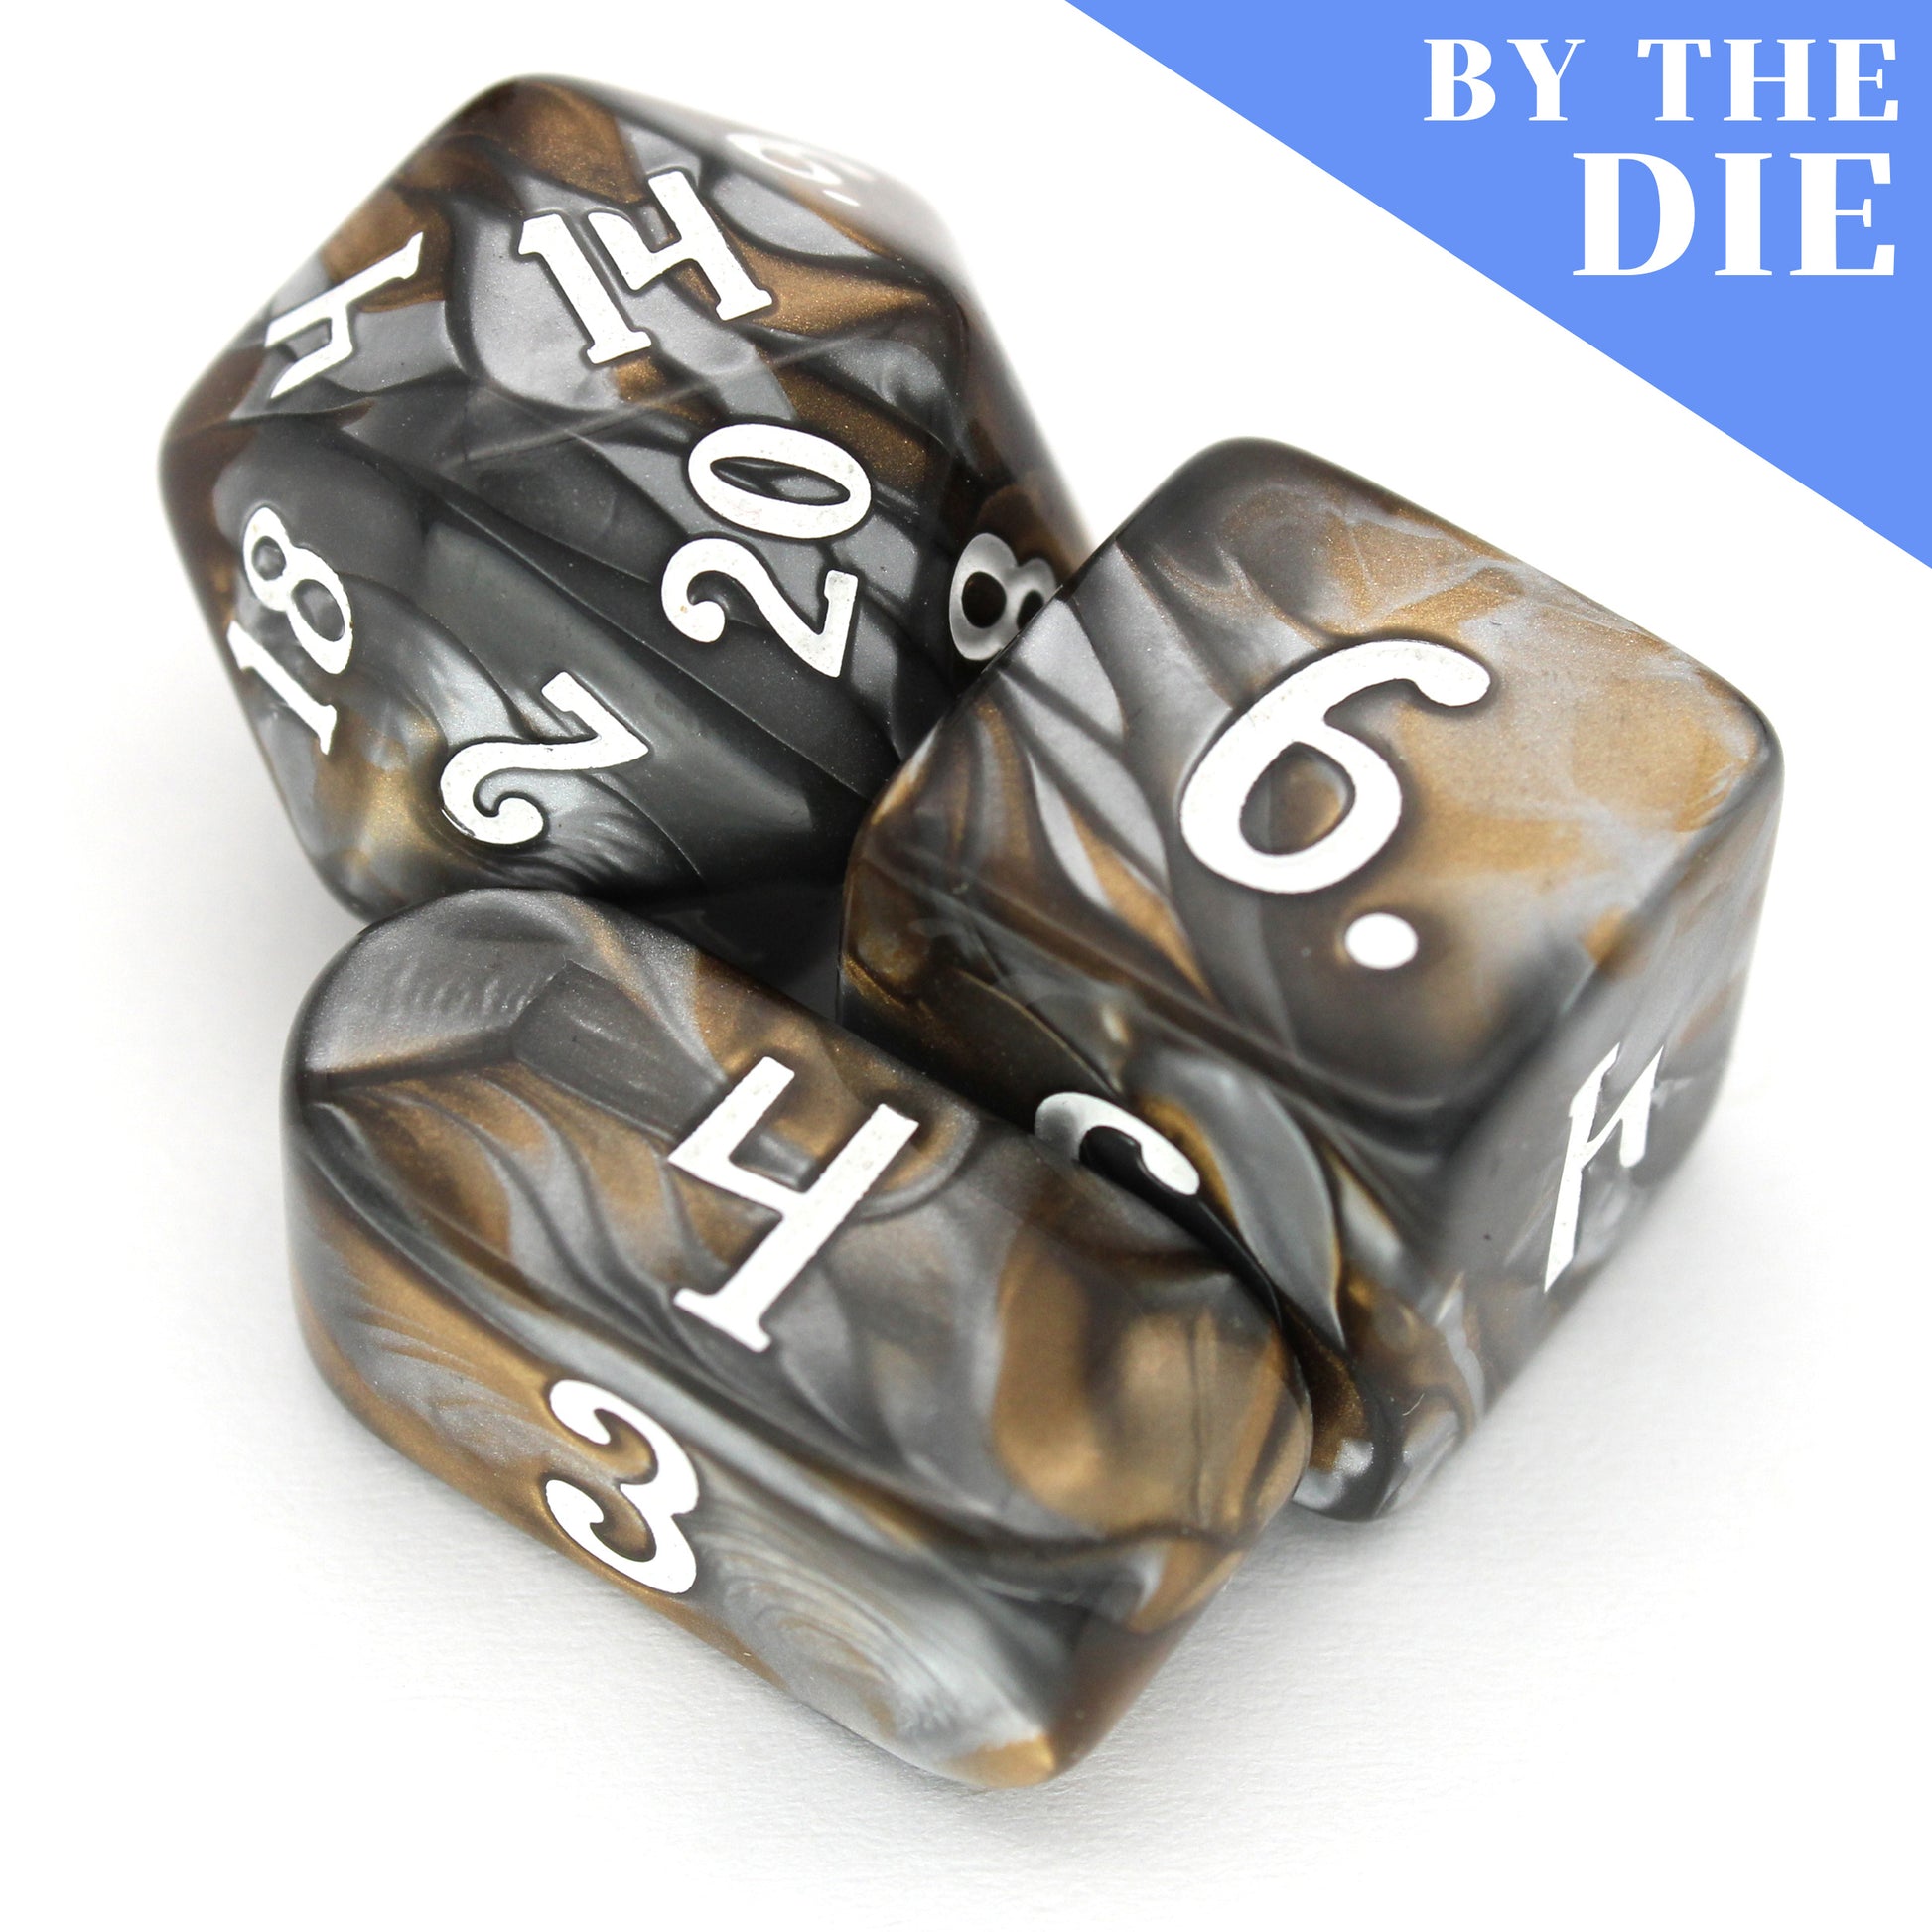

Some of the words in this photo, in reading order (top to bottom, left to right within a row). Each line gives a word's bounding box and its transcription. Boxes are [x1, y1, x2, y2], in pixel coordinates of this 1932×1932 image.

[265, 231, 423, 398] 4
[518, 170, 772, 364] 14
[227, 507, 354, 755] 18
[661, 423, 872, 678] 20
[440, 671, 649, 846] 2
[667, 1056, 919, 1351] 4
[545, 1379, 699, 1594] 3
